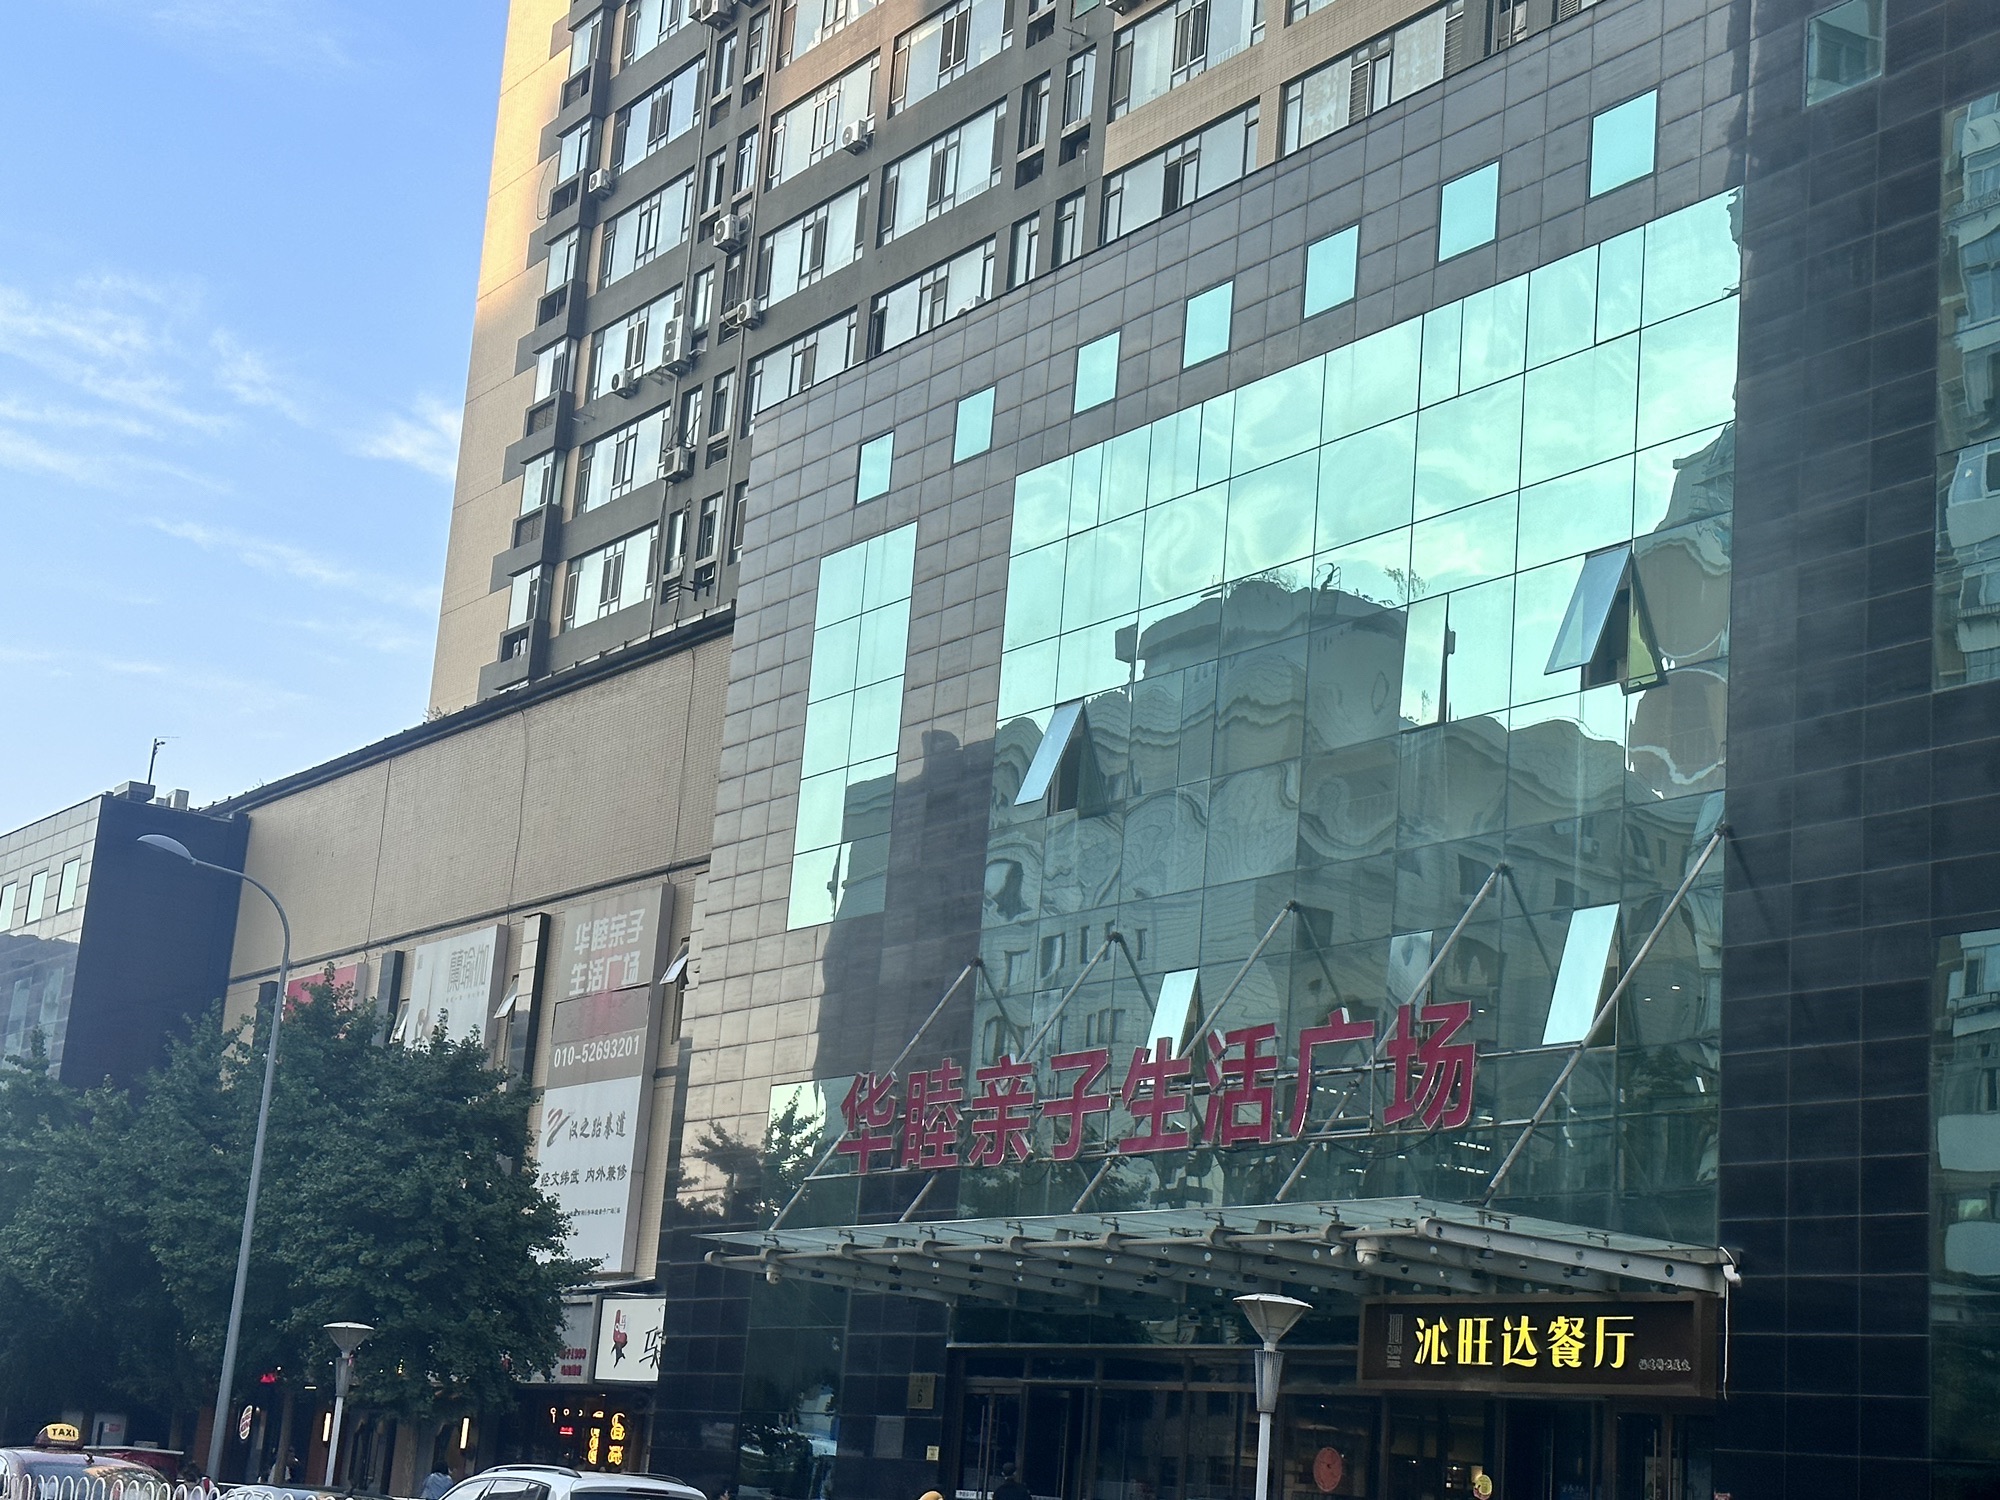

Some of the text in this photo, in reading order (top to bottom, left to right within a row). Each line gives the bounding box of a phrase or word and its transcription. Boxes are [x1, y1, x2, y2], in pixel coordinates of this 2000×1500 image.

[574, 908, 645, 955] 华睦亲子
[569, 950, 640, 996] 生活广场
[554, 1035, 639, 1068] 010-52693201
[837, 1000, 1477, 1175] 华睦亲子生活广场
[585, 1163, 628, 1183] 内外兼修
[52, 1428, 76, 1438] TAXI
